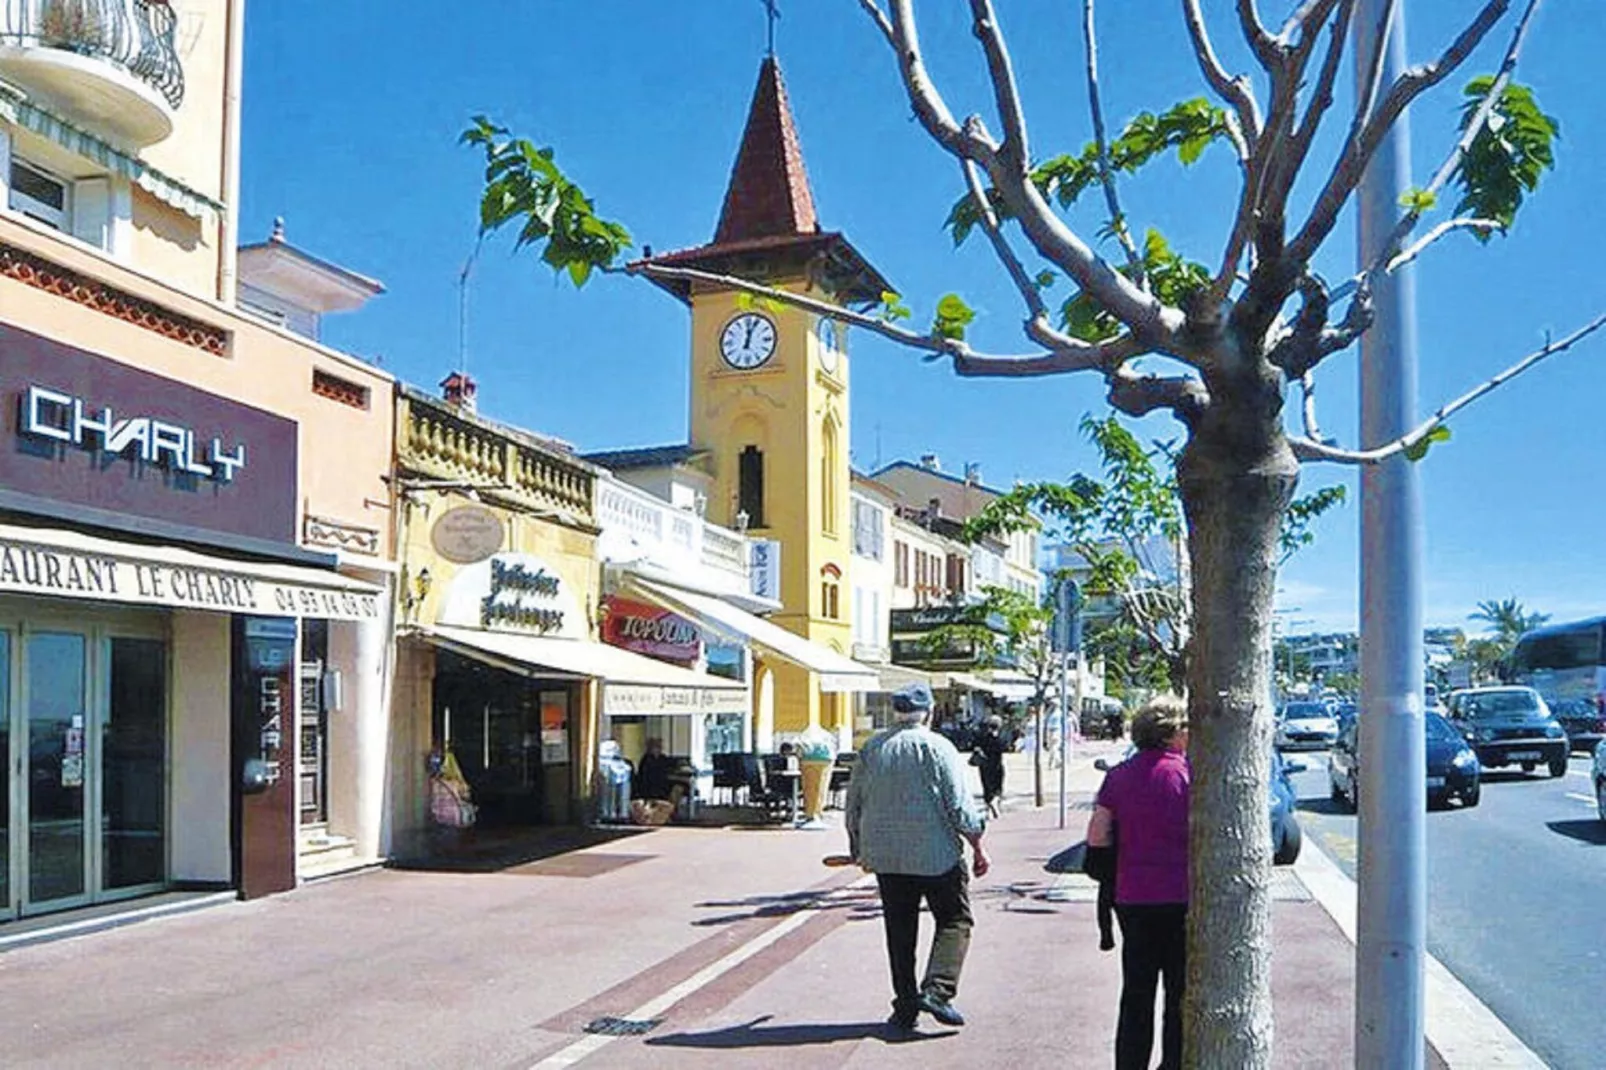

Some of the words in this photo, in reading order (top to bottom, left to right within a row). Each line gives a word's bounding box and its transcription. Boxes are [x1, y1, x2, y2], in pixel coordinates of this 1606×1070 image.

[28, 385, 246, 480] CHARLY
[135, 564, 164, 598] LE
[171, 570, 257, 608] CHARLY
[275, 587, 296, 611] 04
